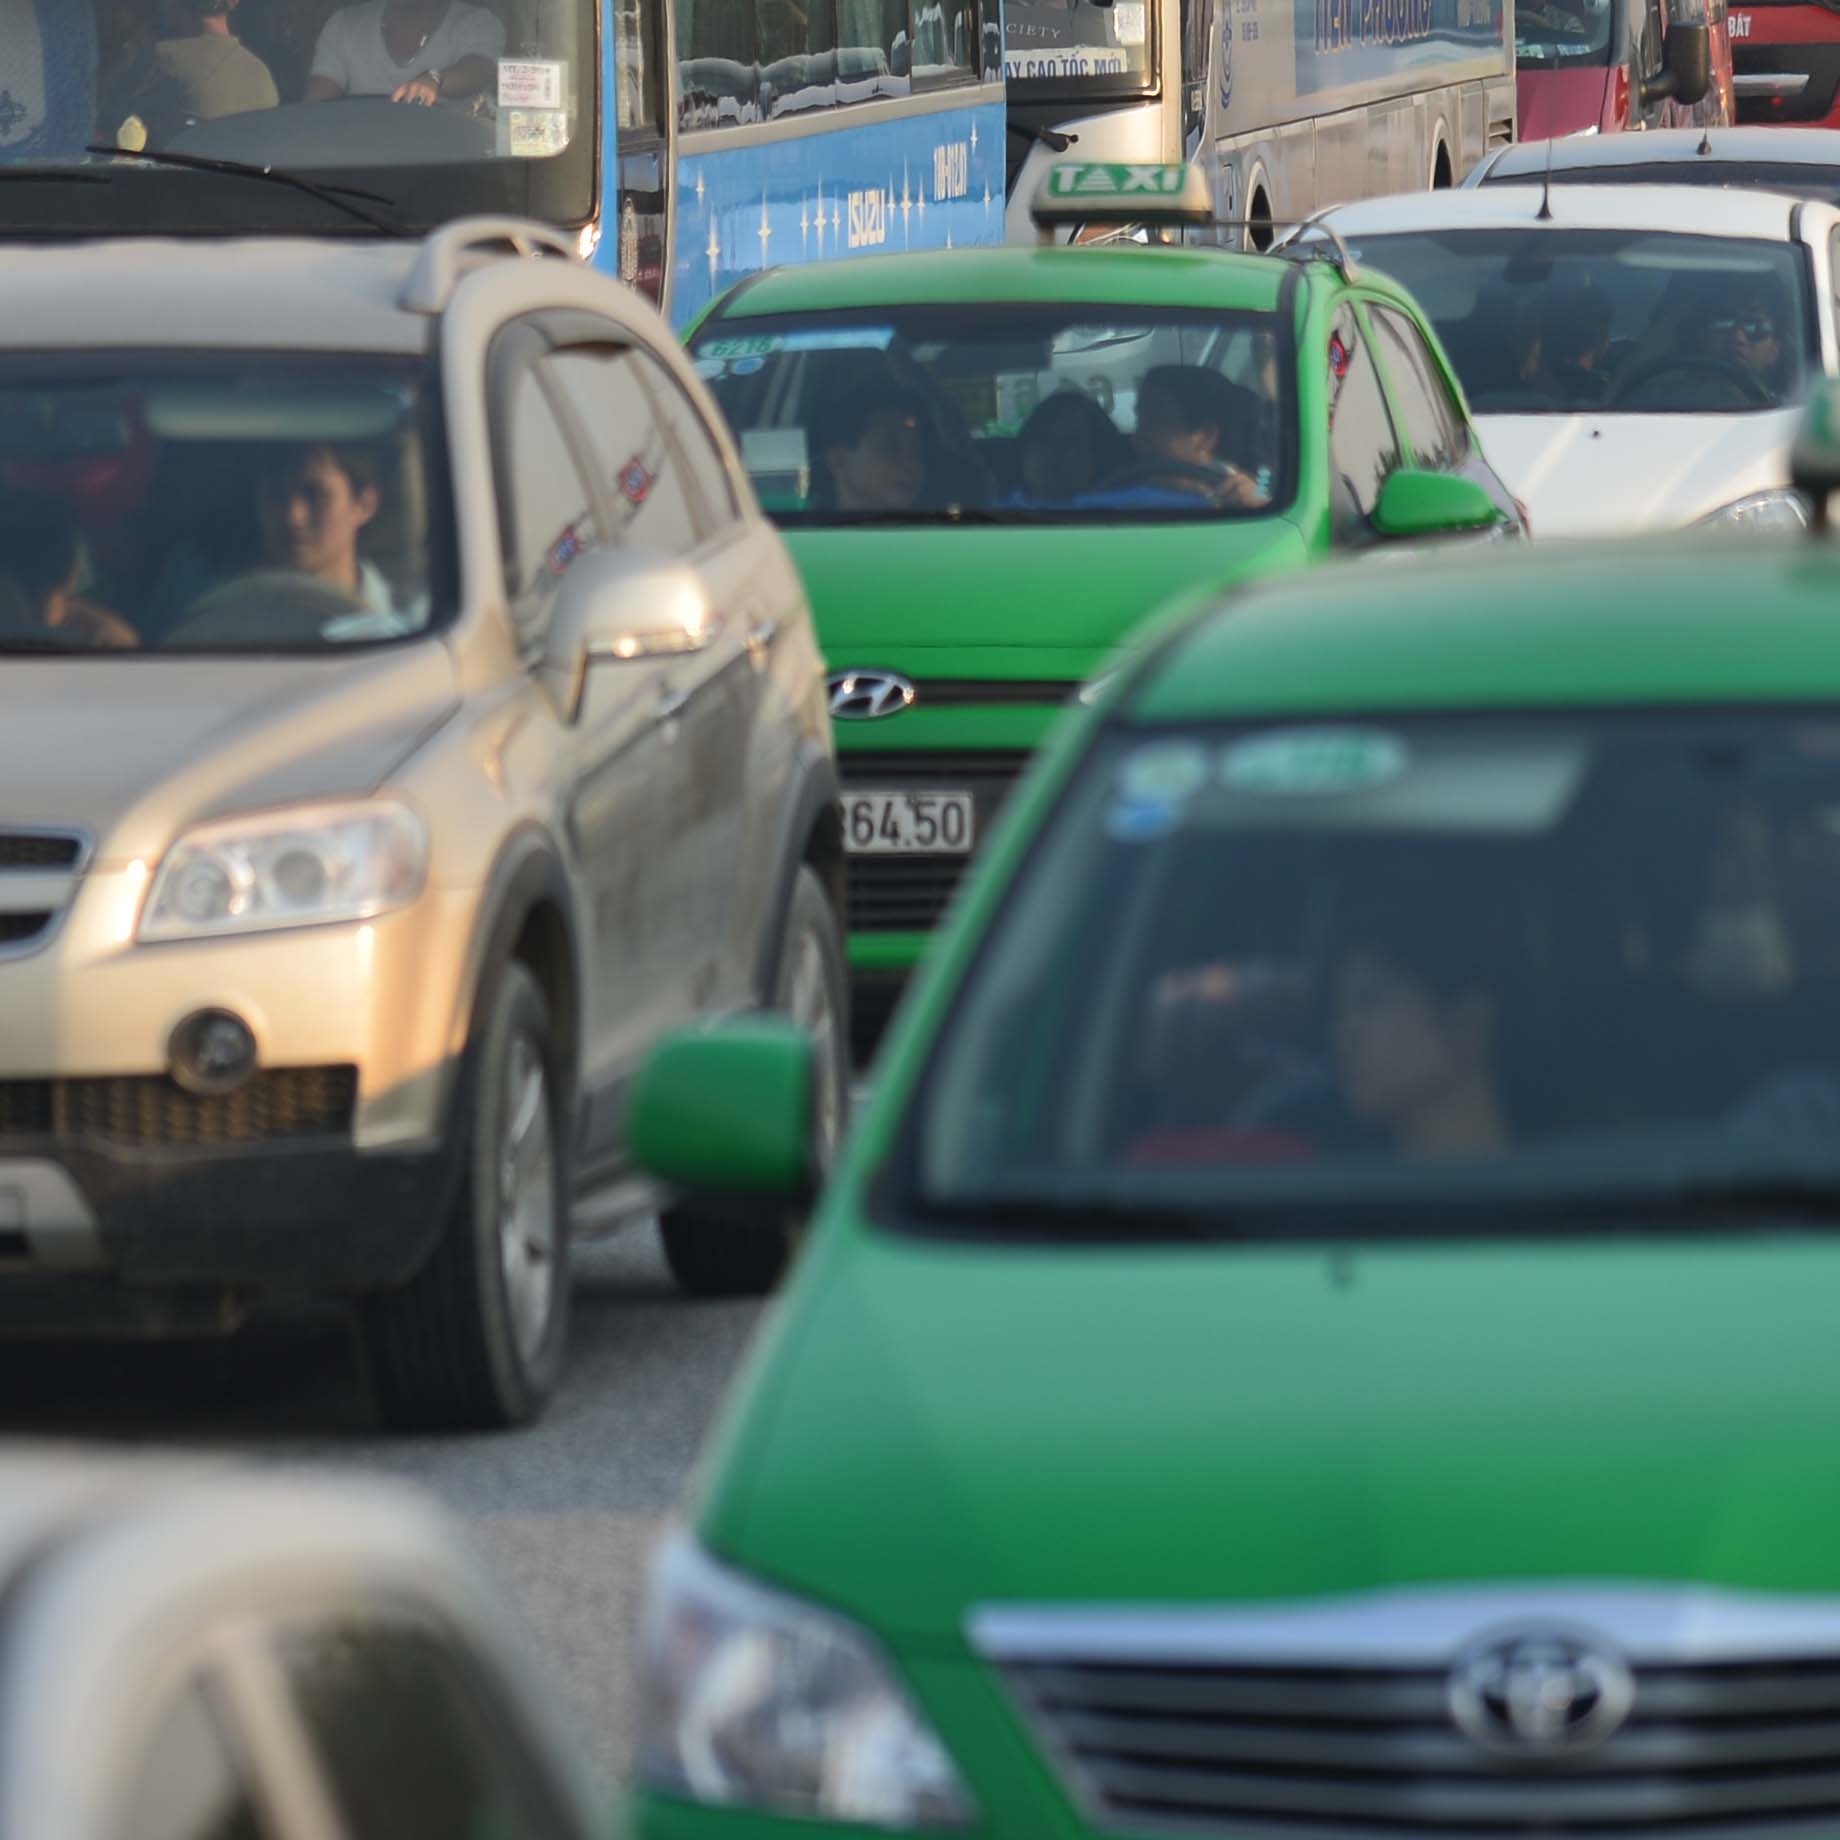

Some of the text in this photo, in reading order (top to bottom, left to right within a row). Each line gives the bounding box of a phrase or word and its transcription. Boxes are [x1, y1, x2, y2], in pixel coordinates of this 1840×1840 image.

[1056, 166, 1179, 192] TAXI
[848, 189, 886, 248] ISUZU
[851, 801, 965, 847] 64.50
